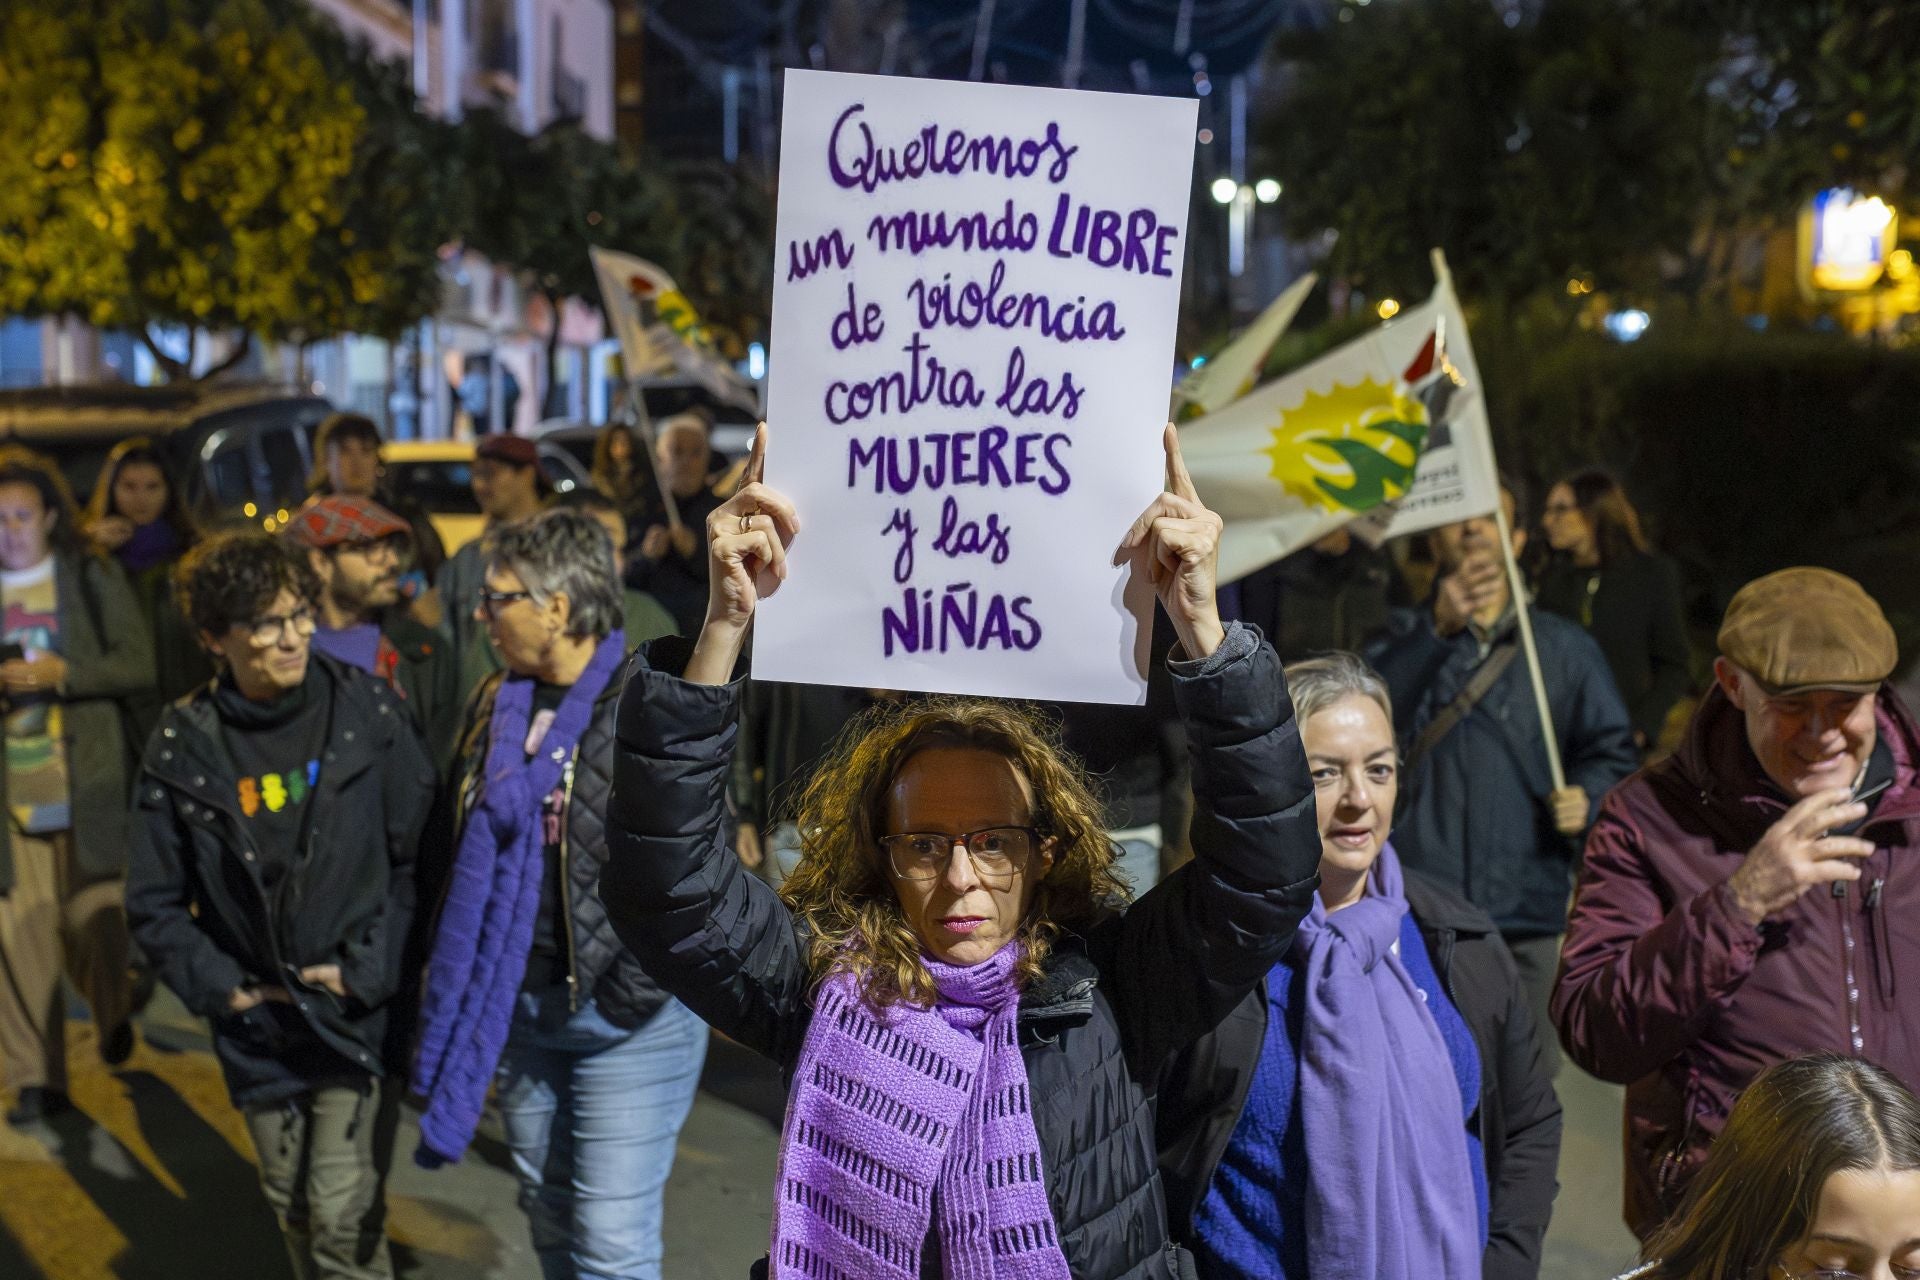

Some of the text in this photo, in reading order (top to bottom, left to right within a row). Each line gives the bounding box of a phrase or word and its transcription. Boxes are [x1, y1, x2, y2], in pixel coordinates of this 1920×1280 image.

[827, 103, 1079, 194] Queremos
[787, 192, 1179, 283] un mundo LIBRE
[830, 258, 1126, 351] de violencia
[824, 331, 1086, 425] contra las
[847, 425, 1072, 496] MUJERES
[881, 494, 1011, 585] y las
